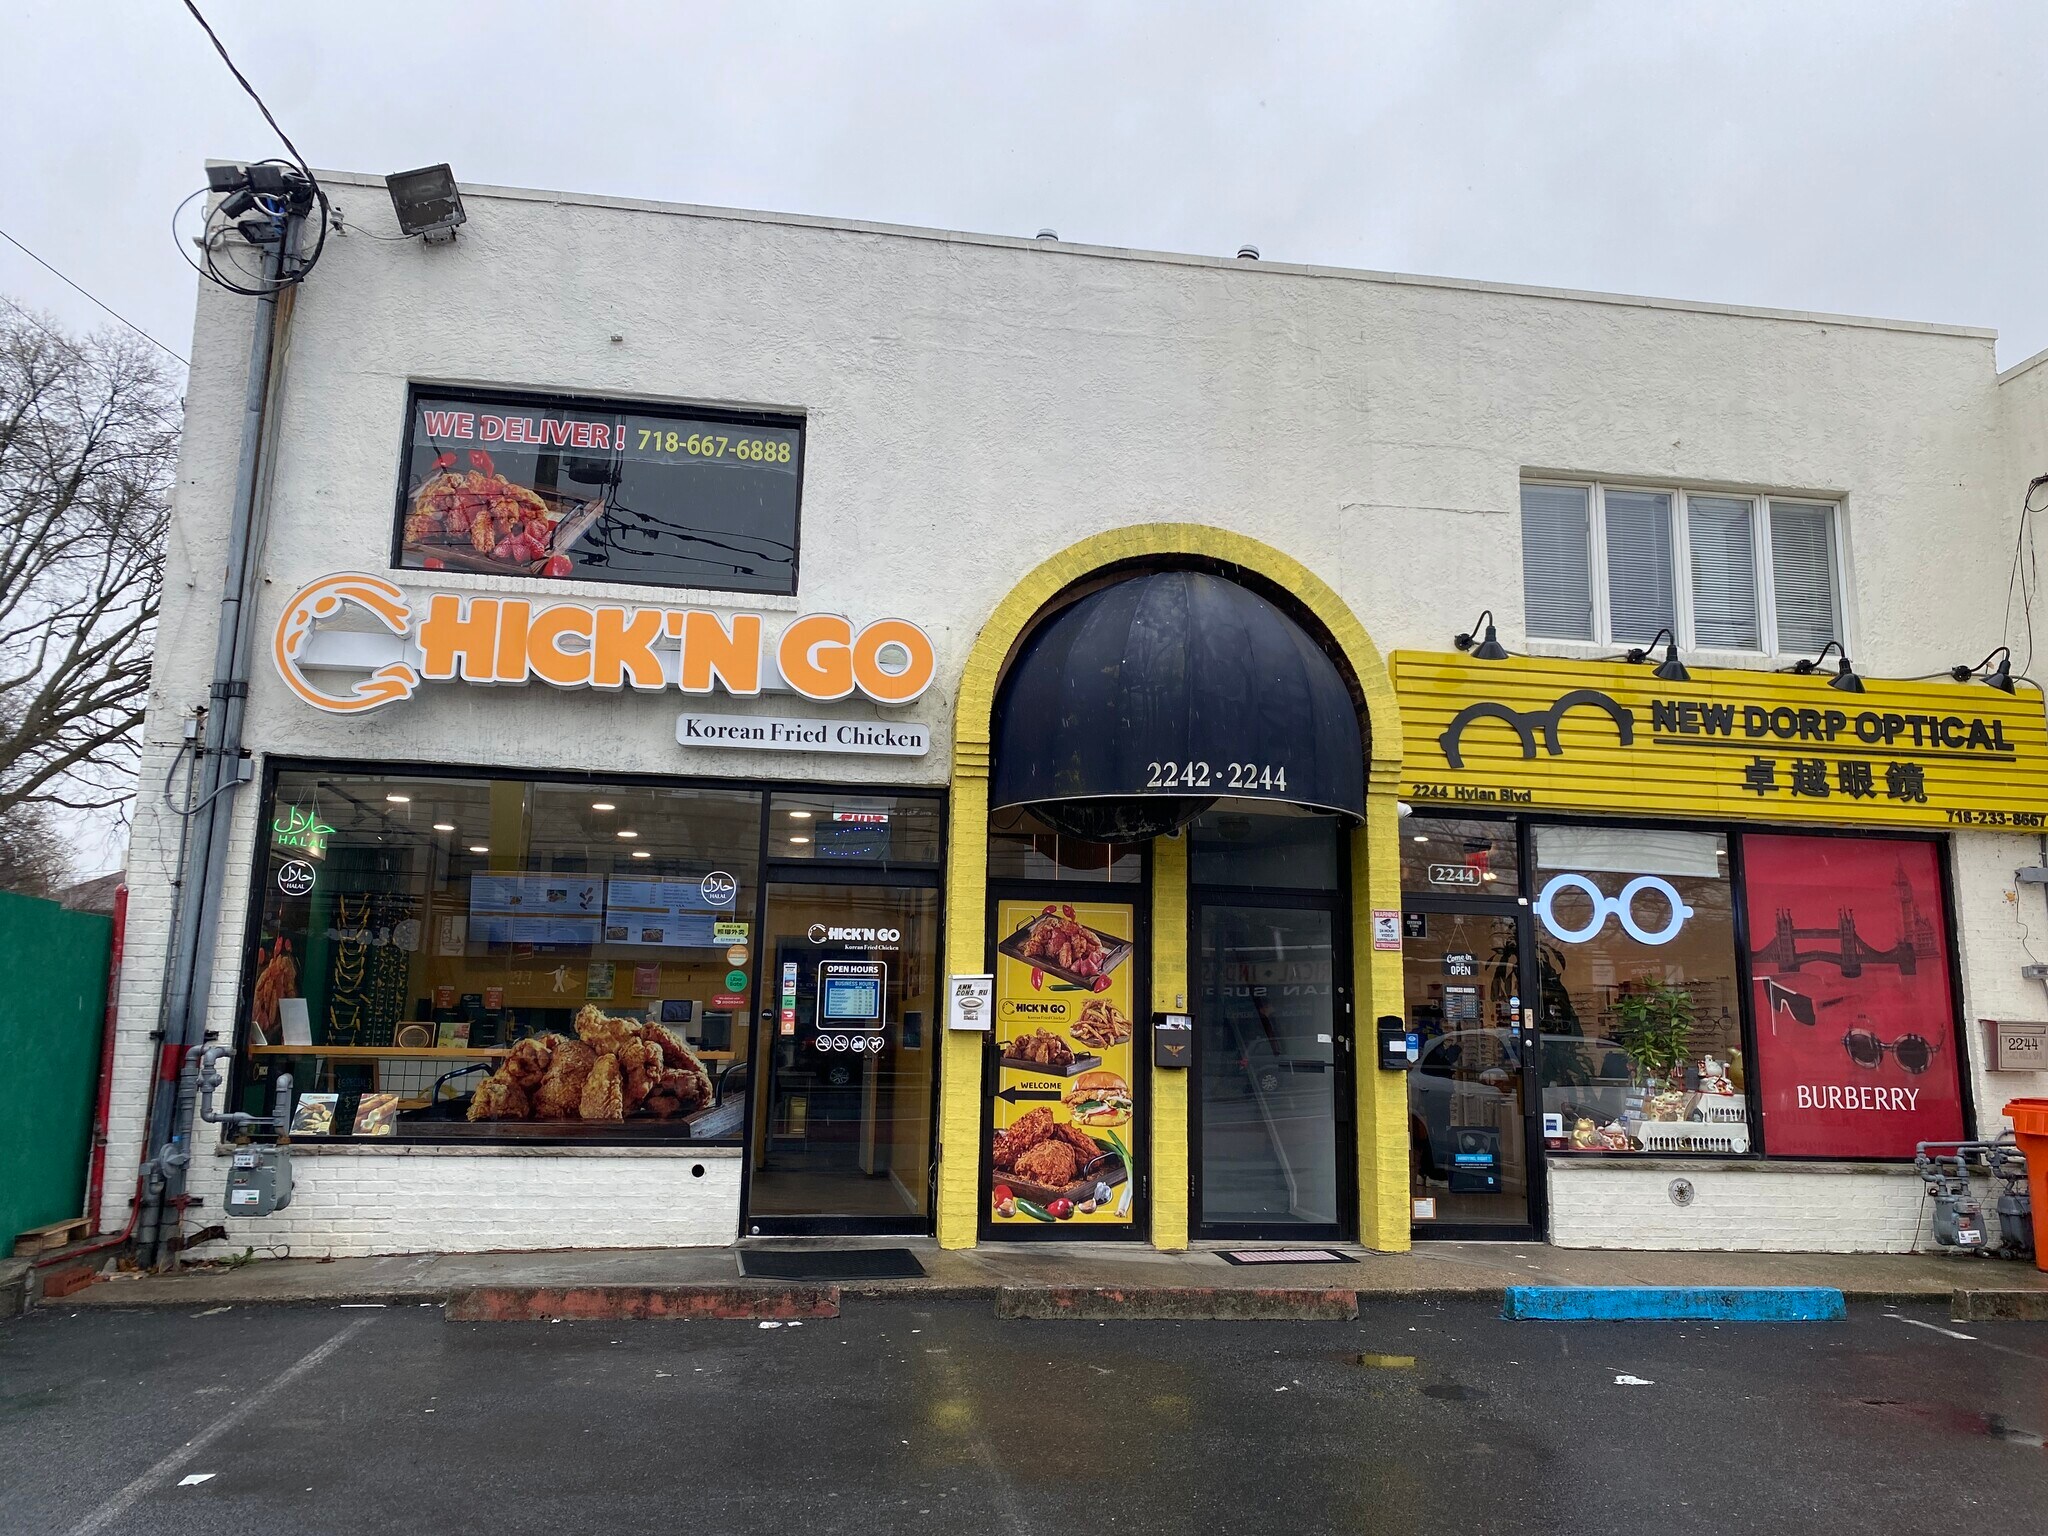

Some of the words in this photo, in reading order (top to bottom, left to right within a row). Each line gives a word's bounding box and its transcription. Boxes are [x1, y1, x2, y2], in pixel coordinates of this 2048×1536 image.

[424, 410, 474, 440] WE
[637, 429, 791, 464] 718-667-6888
[777, 612, 937, 706] GO
[685, 718, 765, 741] Korean
[770, 723, 828, 744] Fried
[836, 725, 923, 748] Chicken
[1652, 699, 1735, 736] NEW
[1744, 706, 1846, 742] DORP
[1855, 711, 2015, 752] OPTICAL
[1742, 755, 1928, 803] 卓越眼鏡
[1412, 784, 1448, 798] 2244
[1455, 786, 1497, 801] Hylan
[1500, 788, 1532, 803] Blvd
[274, 806, 336, 834] حلال
[1946, 809, 2047, 828] 718-233-8667
[278, 834, 326, 849] HALAL
[1436, 867, 1474, 883] 2244
[877, 928, 900, 942] GO
[1446, 954, 1465, 963] Come
[827, 965, 849, 973] OPEN
[850, 965, 879, 973] HOURS
[1450, 965, 1471, 975] OPEN
[1050, 1004, 1066, 1014] GO
[2008, 1037, 2039, 1051] 2244
[1020, 1081, 1062, 1090] WELCOME
[1796, 1085, 1920, 1111] BURBERRY
